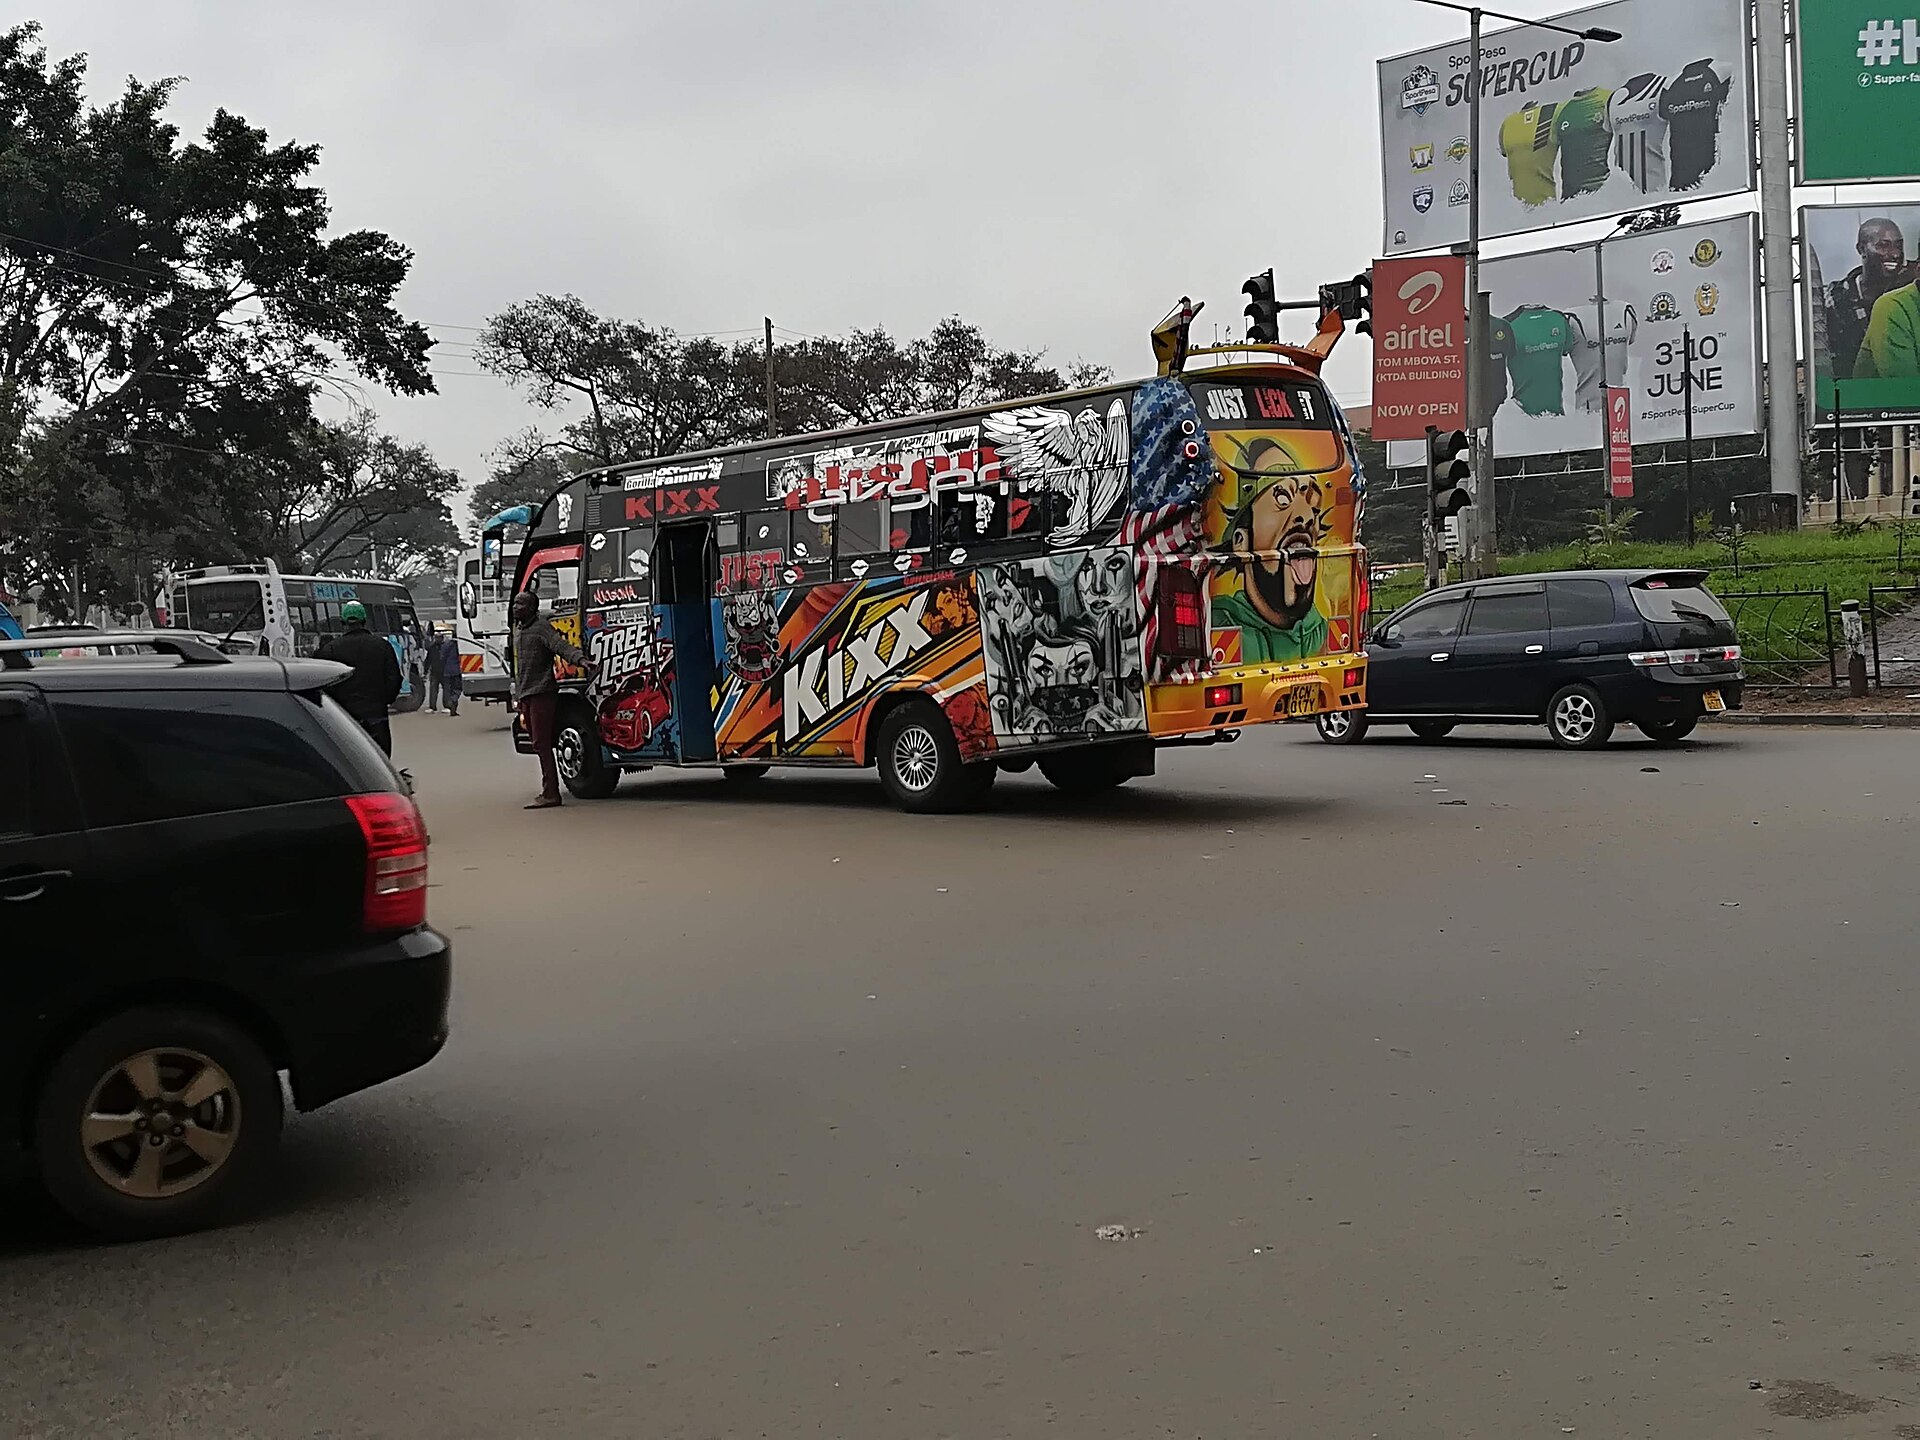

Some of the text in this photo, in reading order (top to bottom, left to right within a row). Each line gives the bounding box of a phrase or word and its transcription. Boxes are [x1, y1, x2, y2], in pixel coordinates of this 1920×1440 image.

[1448, 45, 1507, 71] SpoPesa
[1667, 100, 1711, 114] SportPesa
[1383, 323, 1454, 351] airtel
[1377, 354, 1460, 367] TOM MBOYA ST.
[1376, 369, 1462, 382] (KTDA BUILDING)
[1647, 366, 1723, 398] JUNE
[1206, 388, 1248, 420] JUST
[1377, 402, 1459, 417] NOW OPEN
[1641, 402, 1736, 420] #SportPesSuperCup
[1612, 427, 1630, 443] airtel
[656, 471, 708, 487] Family
[625, 485, 720, 520] KIXX
[716, 553, 783, 594] JUST
[590, 617, 661, 665] STREET
[600, 642, 665, 687] LEGAL
